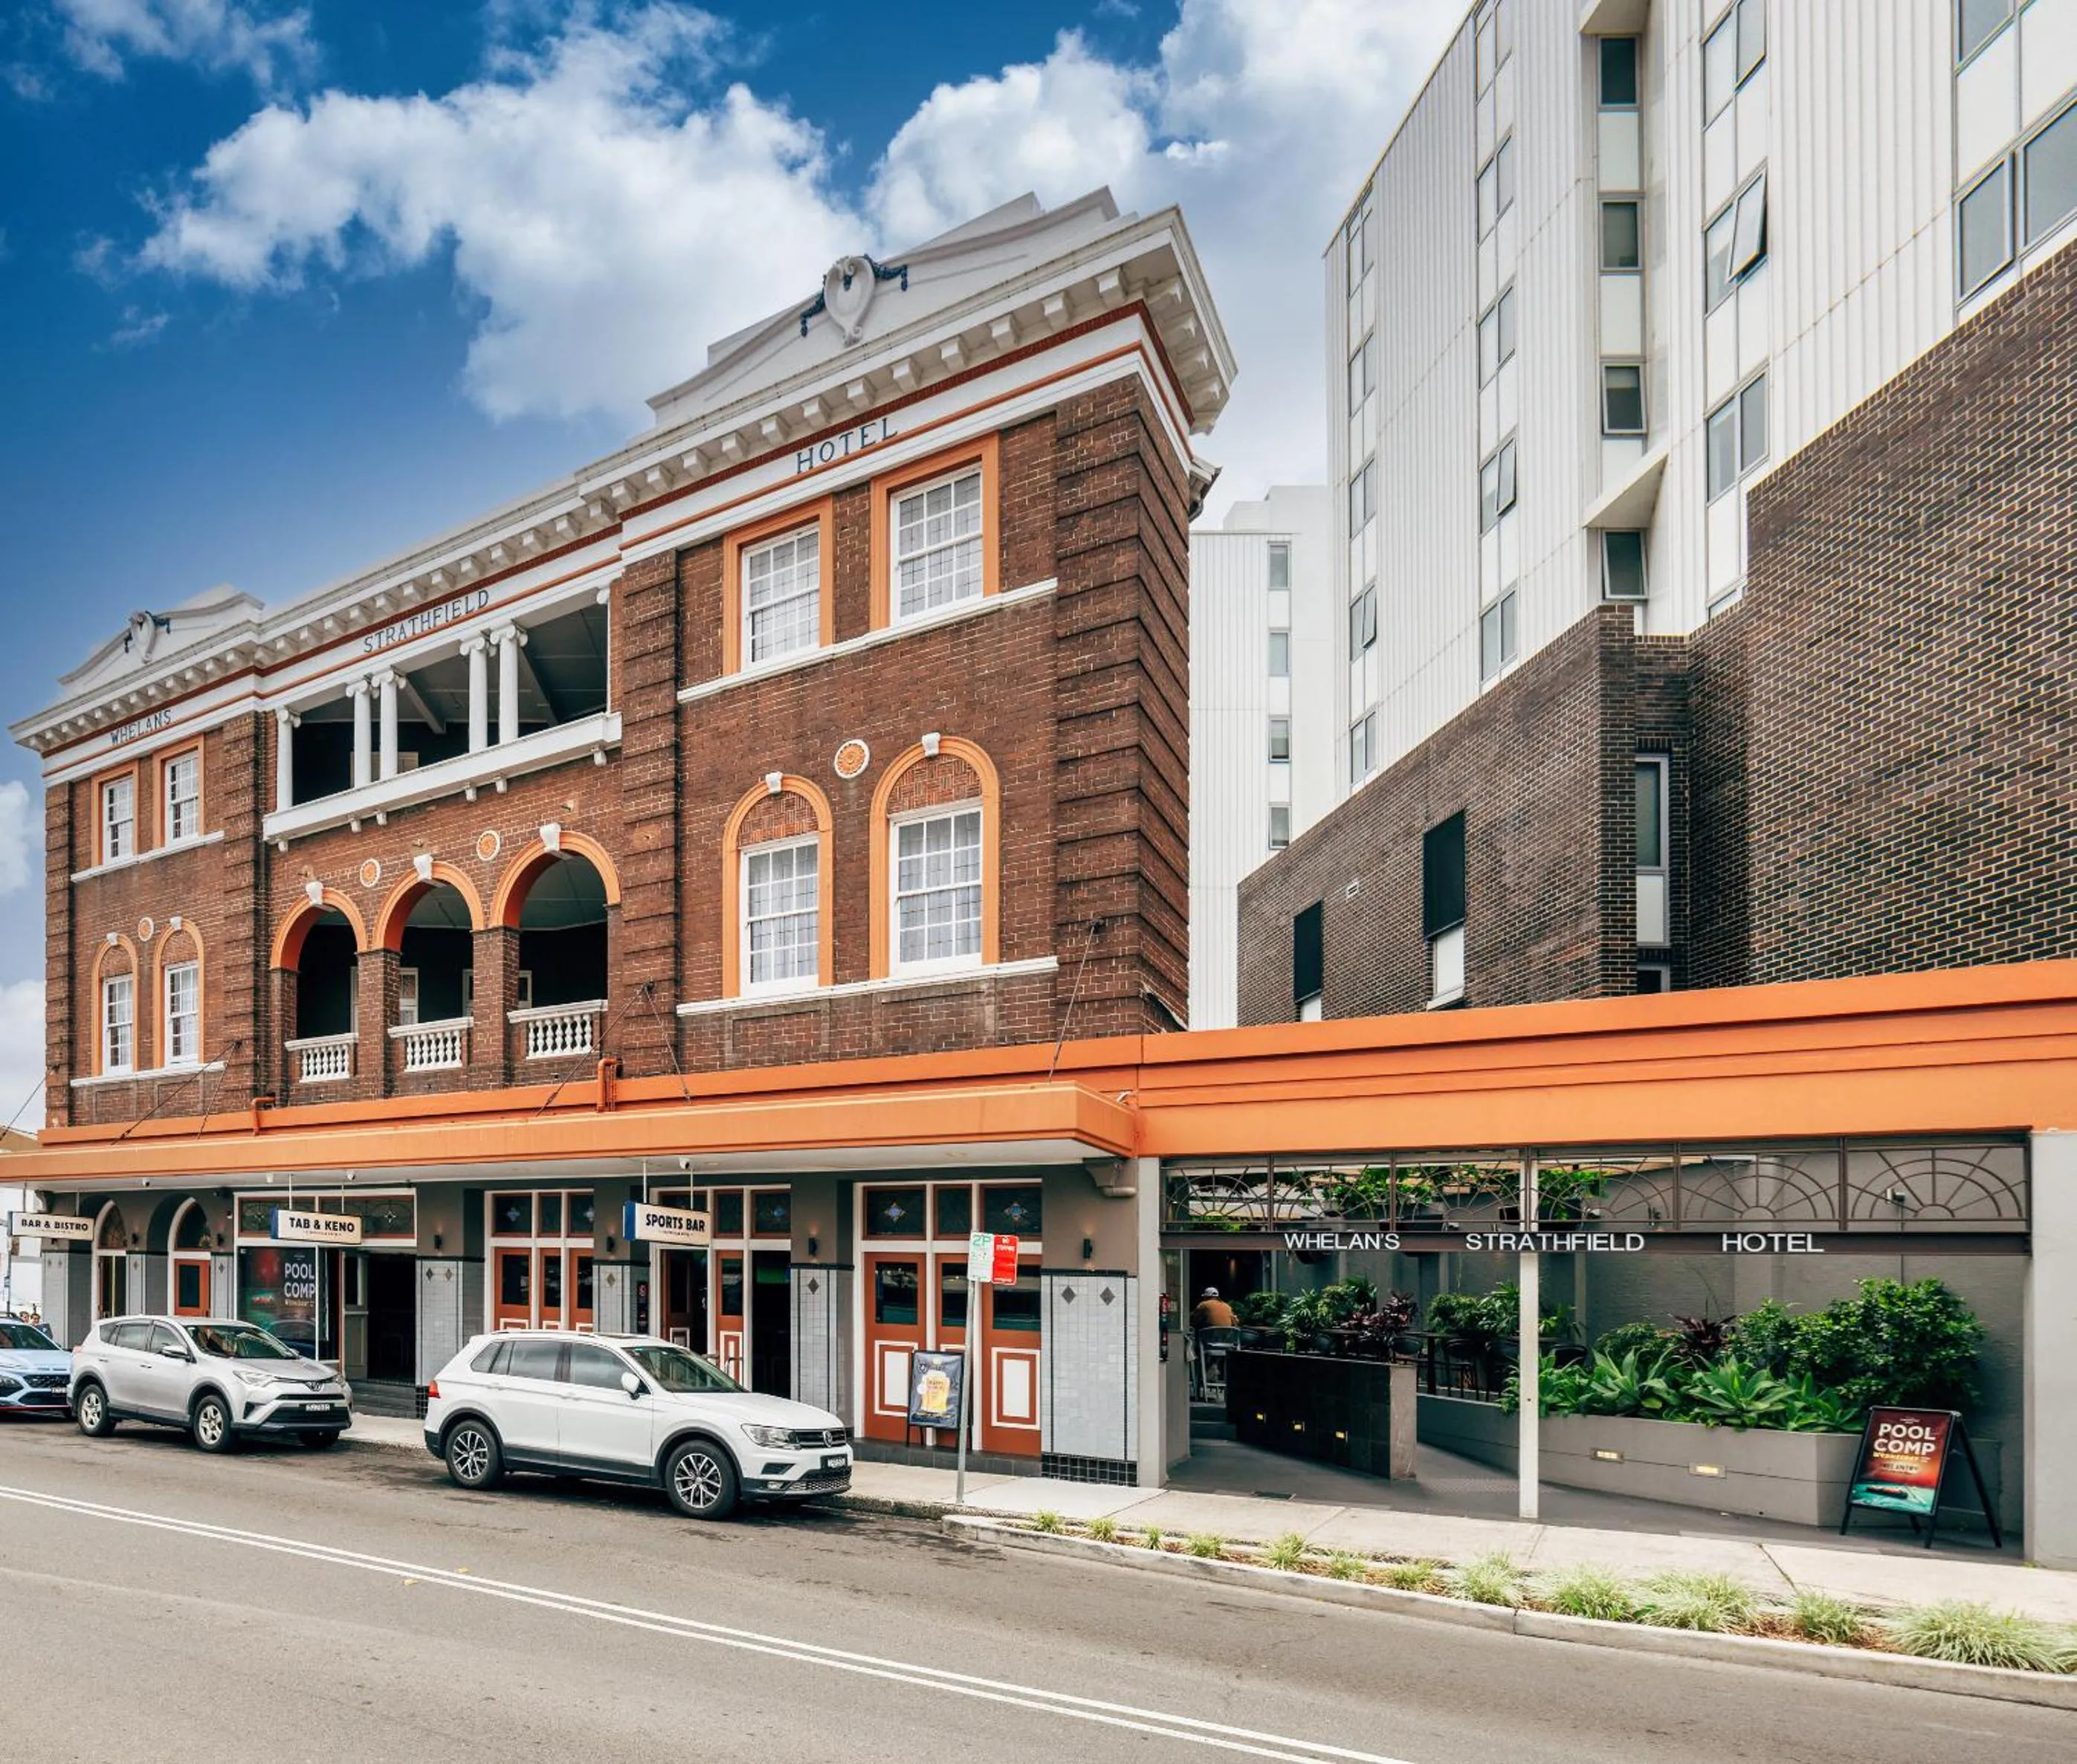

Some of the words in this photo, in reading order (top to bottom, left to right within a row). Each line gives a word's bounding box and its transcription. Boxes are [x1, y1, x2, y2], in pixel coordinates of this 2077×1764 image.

[797, 418, 897, 474] HOTEL
[364, 589, 489, 653] STRATHFIELD
[22, 1219, 41, 1227] BAR
[54, 1221, 88, 1231] BISTRO
[289, 1218, 310, 1229] TAB
[314, 1220, 320, 1230] &
[325, 1221, 355, 1232] KENO
[646, 1214, 683, 1230] SPORTS
[687, 1218, 705, 1232] BAR
[972, 1235, 991, 1247] 2P
[1284, 1233, 1401, 1250] WHELAN'S
[1466, 1233, 1644, 1251] STRATHFIELD
[1722, 1233, 1825, 1253] HOTEL
[285, 1263, 315, 1279] POOL
[284, 1282, 316, 1298] COMP
[1879, 1423, 1936, 1441] POOL
[1874, 1438, 1936, 1456] COMP
